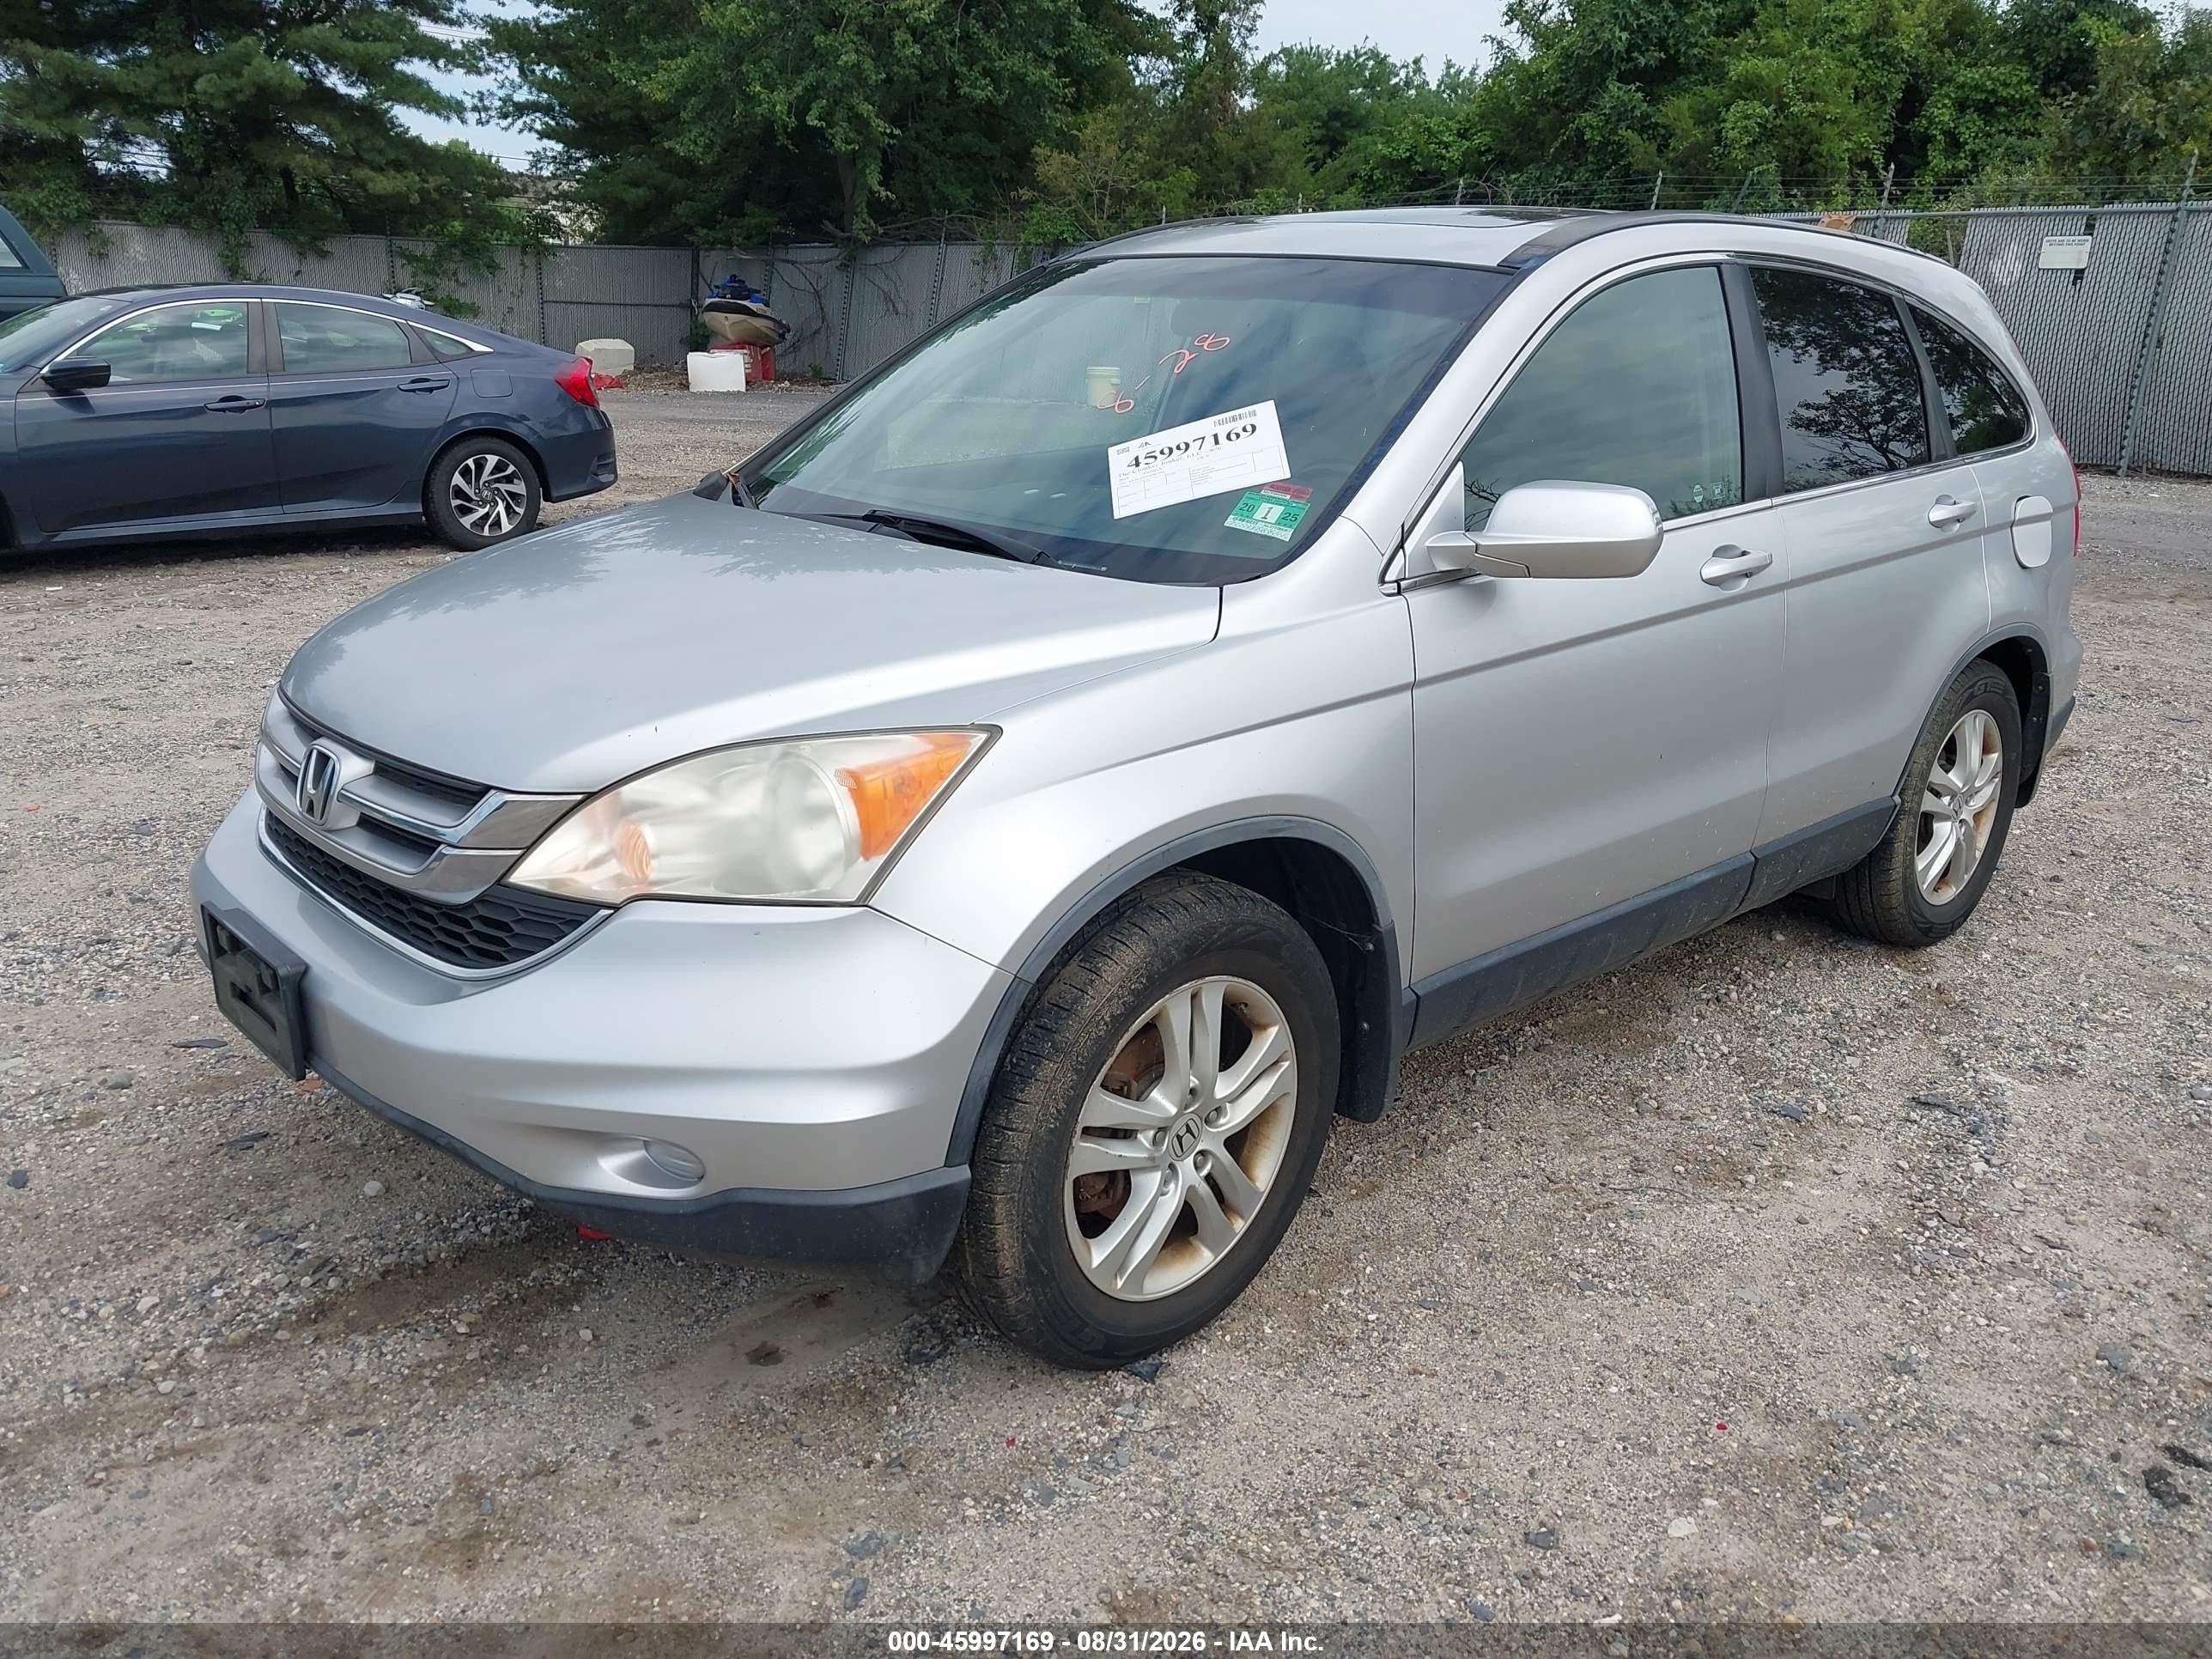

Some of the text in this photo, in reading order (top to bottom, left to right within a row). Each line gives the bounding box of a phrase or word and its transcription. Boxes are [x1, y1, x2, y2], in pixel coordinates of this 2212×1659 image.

[1127, 423, 1257, 468] 45997169
[1239, 502, 1300, 522] 20 1 25
